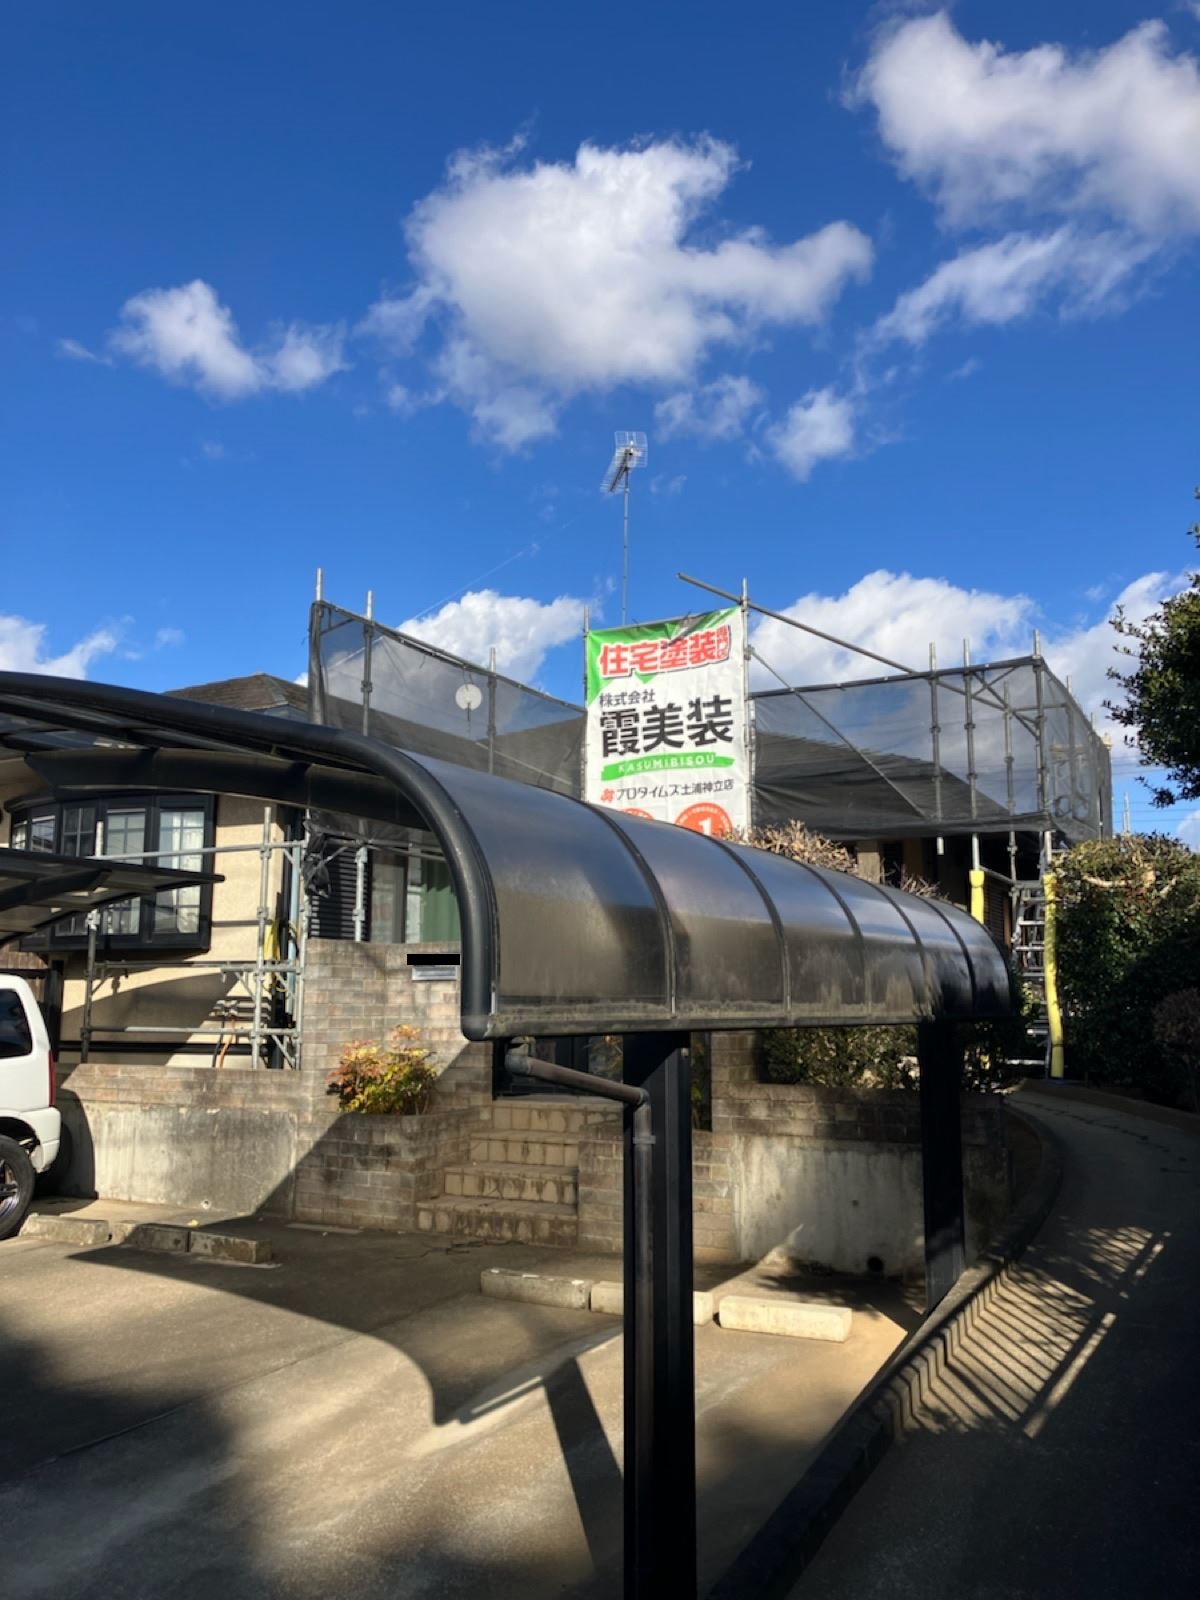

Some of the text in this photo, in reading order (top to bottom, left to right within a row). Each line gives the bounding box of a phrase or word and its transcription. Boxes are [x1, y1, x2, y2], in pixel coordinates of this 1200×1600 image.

[600, 631, 716, 676] 住宅塗装
[600, 688, 656, 708] 株式会社
[600, 694, 734, 758] 霞美装
[618, 755, 715, 774] KASUMIBISOU
